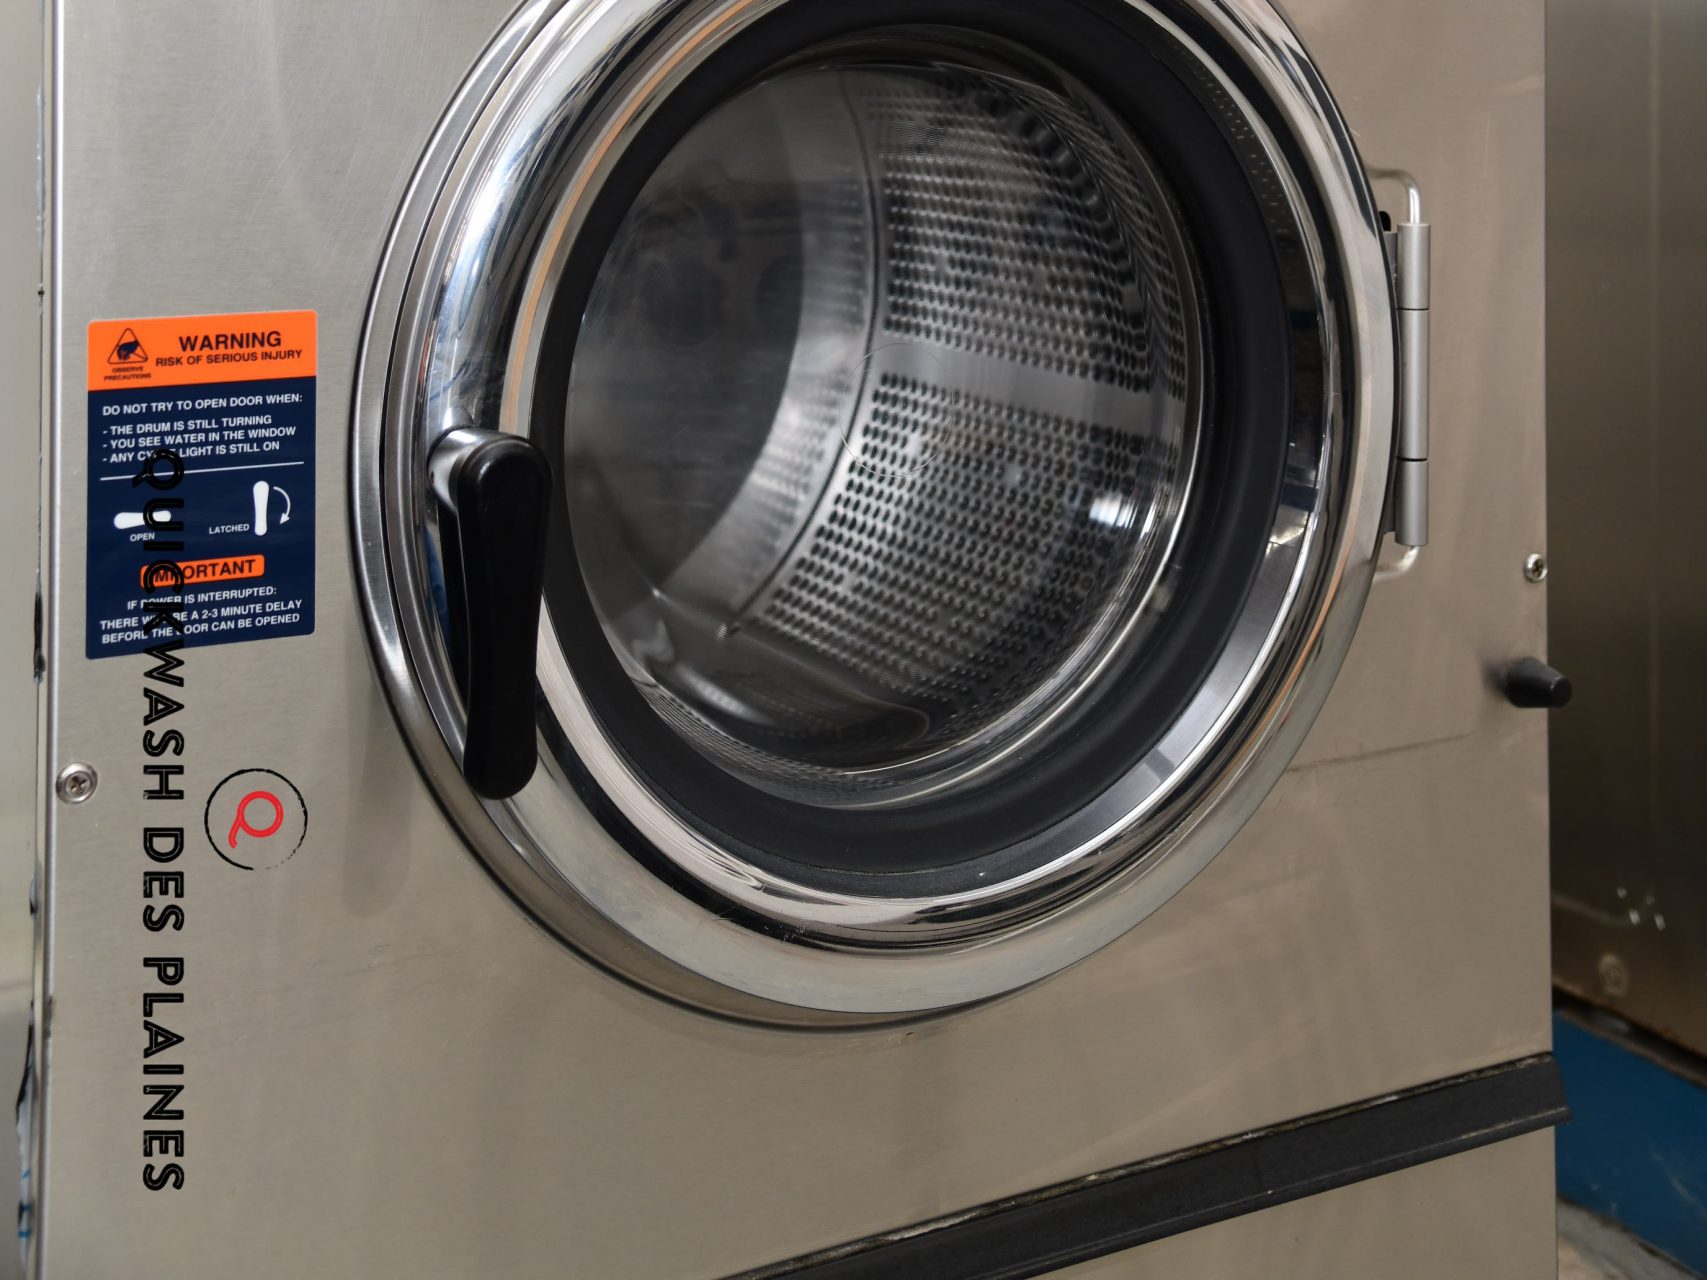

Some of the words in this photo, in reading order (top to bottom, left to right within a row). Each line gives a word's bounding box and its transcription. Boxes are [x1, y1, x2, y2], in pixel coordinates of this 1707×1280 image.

[179, 331, 281, 352] WARNING
[156, 356, 183, 367] RISK
[187, 355, 203, 364] OF
[206, 352, 257, 364] SERIOUS
[261, 349, 302, 360] INJURY
[104, 373, 151, 381] PRECAUTIONS
[103, 405, 120, 416] DO
[123, 403, 148, 415] NOT
[151, 402, 173, 412] TRY
[176, 400, 192, 410] TO
[195, 398, 227, 409] OPEN
[230, 396, 263, 407] DOOR
[266, 393, 302, 404] WHEN:
[110, 425, 133, 435] THE
[137, 421, 171, 433] DRUM
[173, 421, 184, 430] IS
[187, 418, 219, 430] STILL
[221, 415, 272, 427] TURNING
[110, 438, 136, 449] YOU
[139, 437, 161, 447] SEE
[164, 433, 205, 445] WATER
[209, 432, 220, 441] IN
[223, 430, 245, 440] THE
[248, 426, 296, 439] WINDOW
[110, 453, 135, 464] ANY
[179, 445, 213, 458] LIGHT
[215, 444, 226, 454] IS
[229, 442, 260, 453] STILL
[263, 441, 280, 451] ON
[130, 532, 155, 542] OPEN
[209, 524, 250, 534] LATCHED
[127, 601, 137, 610] IF
[184, 595, 195, 604] IS
[198, 586, 277, 602] INTERRUPTED:
[100, 616, 139, 631] THERE
[191, 611, 199, 620] A
[202, 607, 218, 619] 2-3
[221, 604, 263, 617] MINUTE
[266, 600, 302, 614] DELAY
[152, 626, 173, 638] THE
[211, 621, 235, 631] CAN
[238, 619, 252, 628] BE
[255, 614, 300, 626] OPENED
